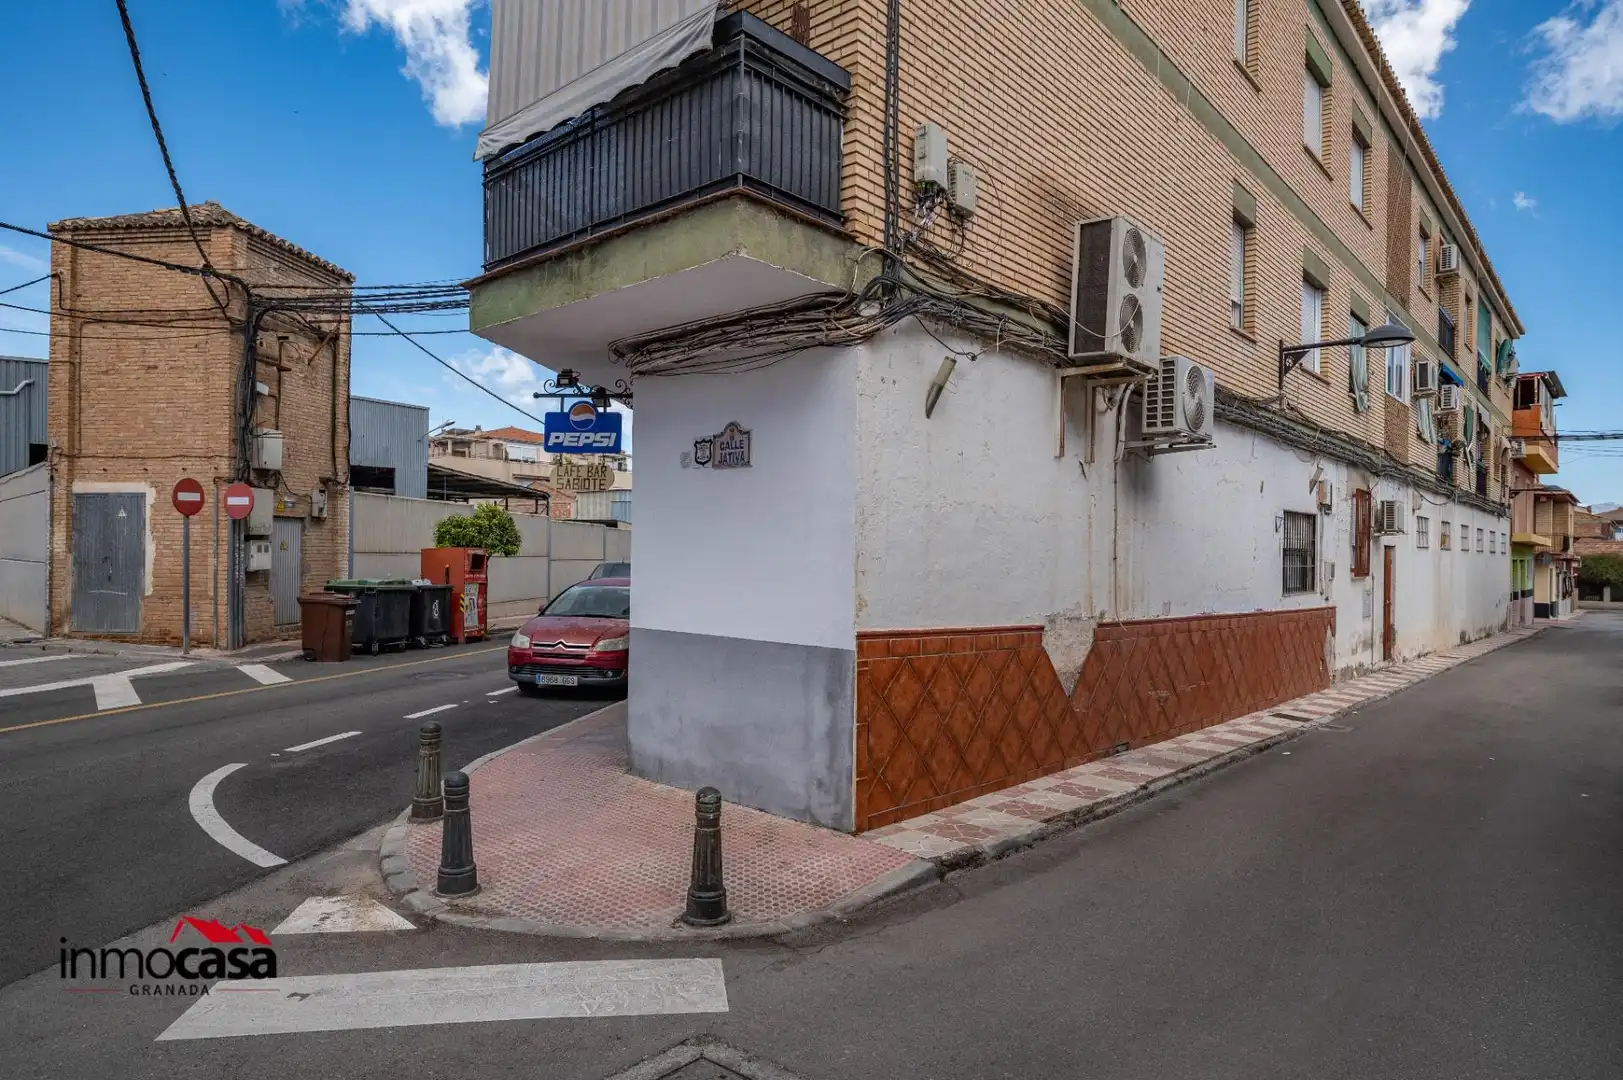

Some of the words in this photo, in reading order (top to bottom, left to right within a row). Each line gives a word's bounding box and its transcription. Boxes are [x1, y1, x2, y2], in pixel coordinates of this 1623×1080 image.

[548, 432, 616, 447] PEPSI
[720, 440, 745, 451] CALLE
[556, 465, 581, 477] CAFE
[587, 466, 607, 478] BAR
[556, 478, 607, 490] SABIOTE
